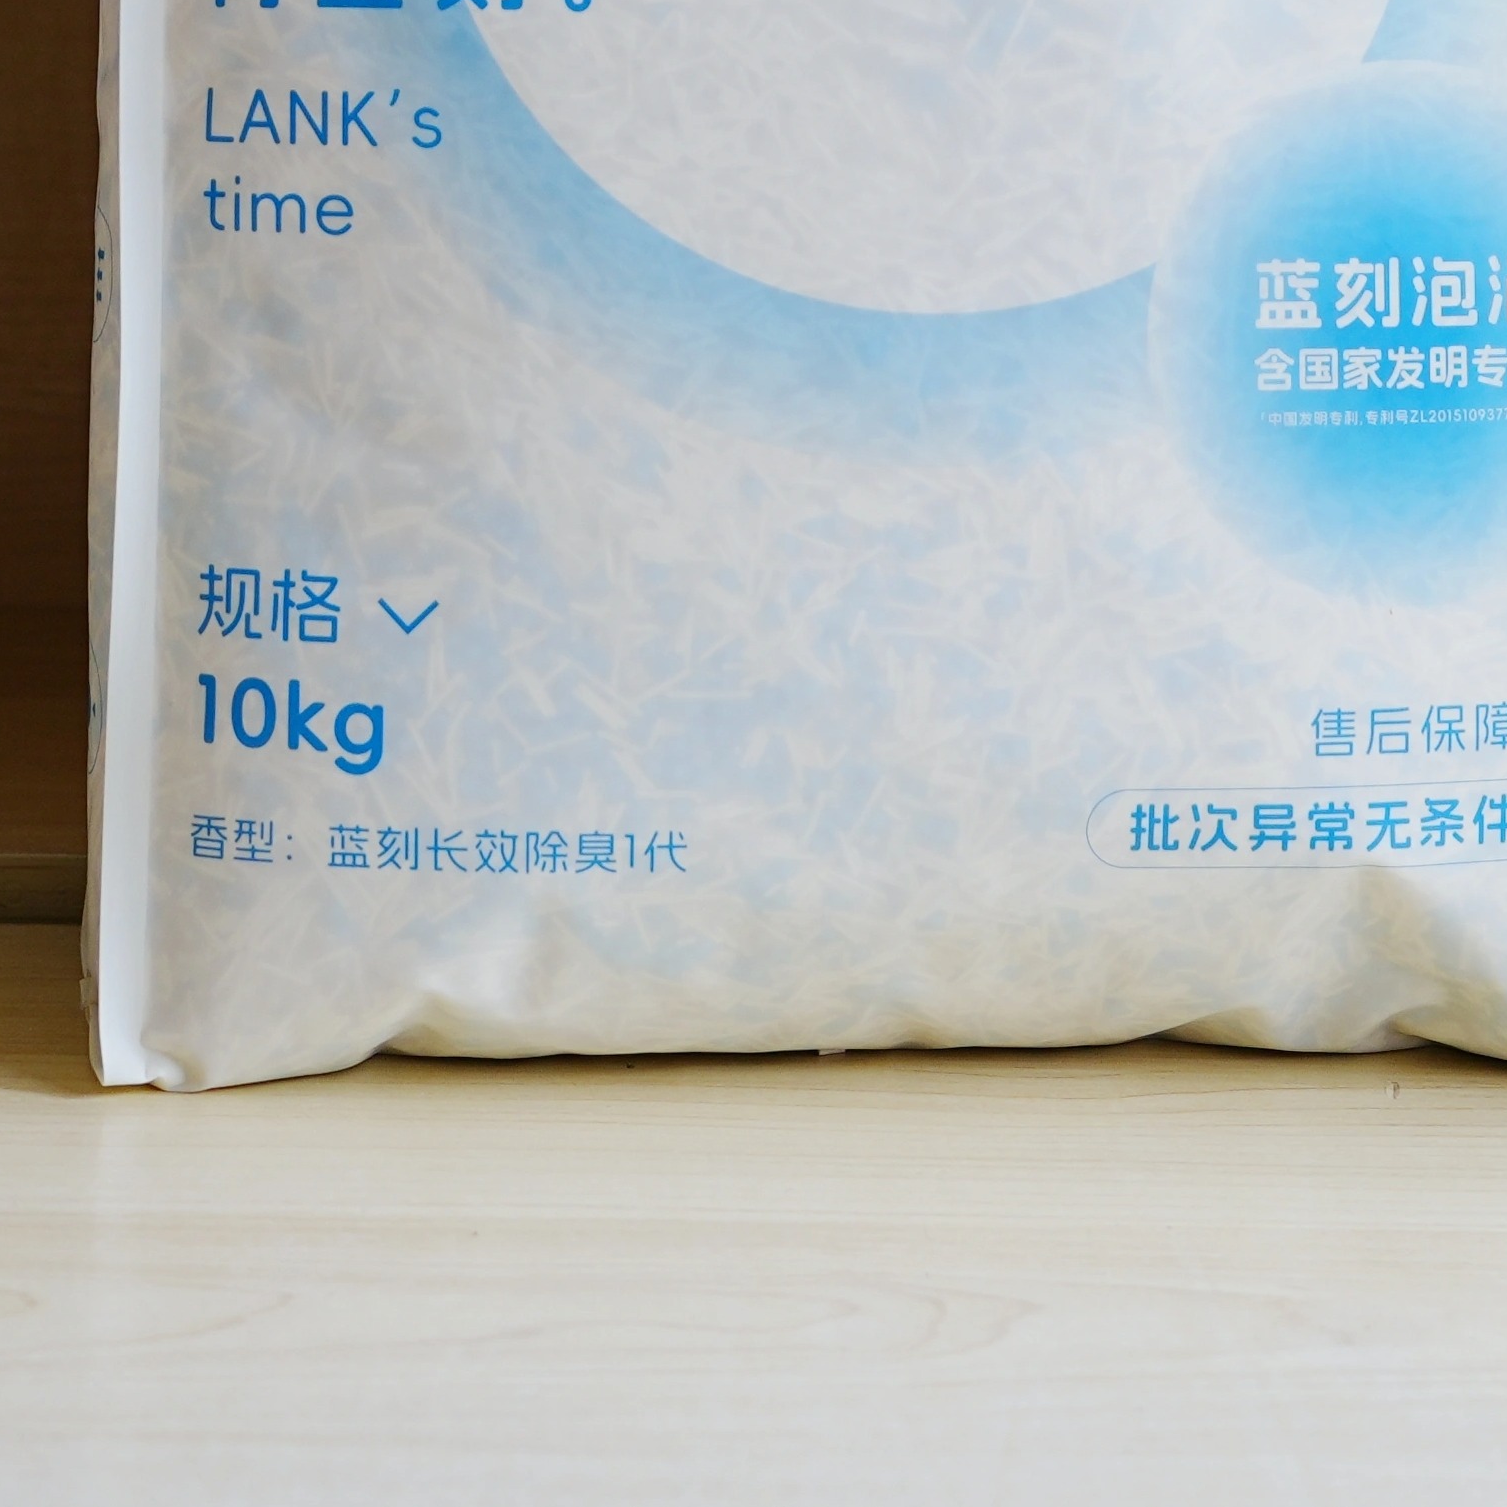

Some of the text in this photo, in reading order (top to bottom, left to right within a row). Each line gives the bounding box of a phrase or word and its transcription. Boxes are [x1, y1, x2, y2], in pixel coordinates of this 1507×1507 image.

[204, 87, 443, 149] LANK's
[203, 175, 354, 236] time
[197, 564, 342, 643] 规格
[197, 673, 384, 775] 10kg
